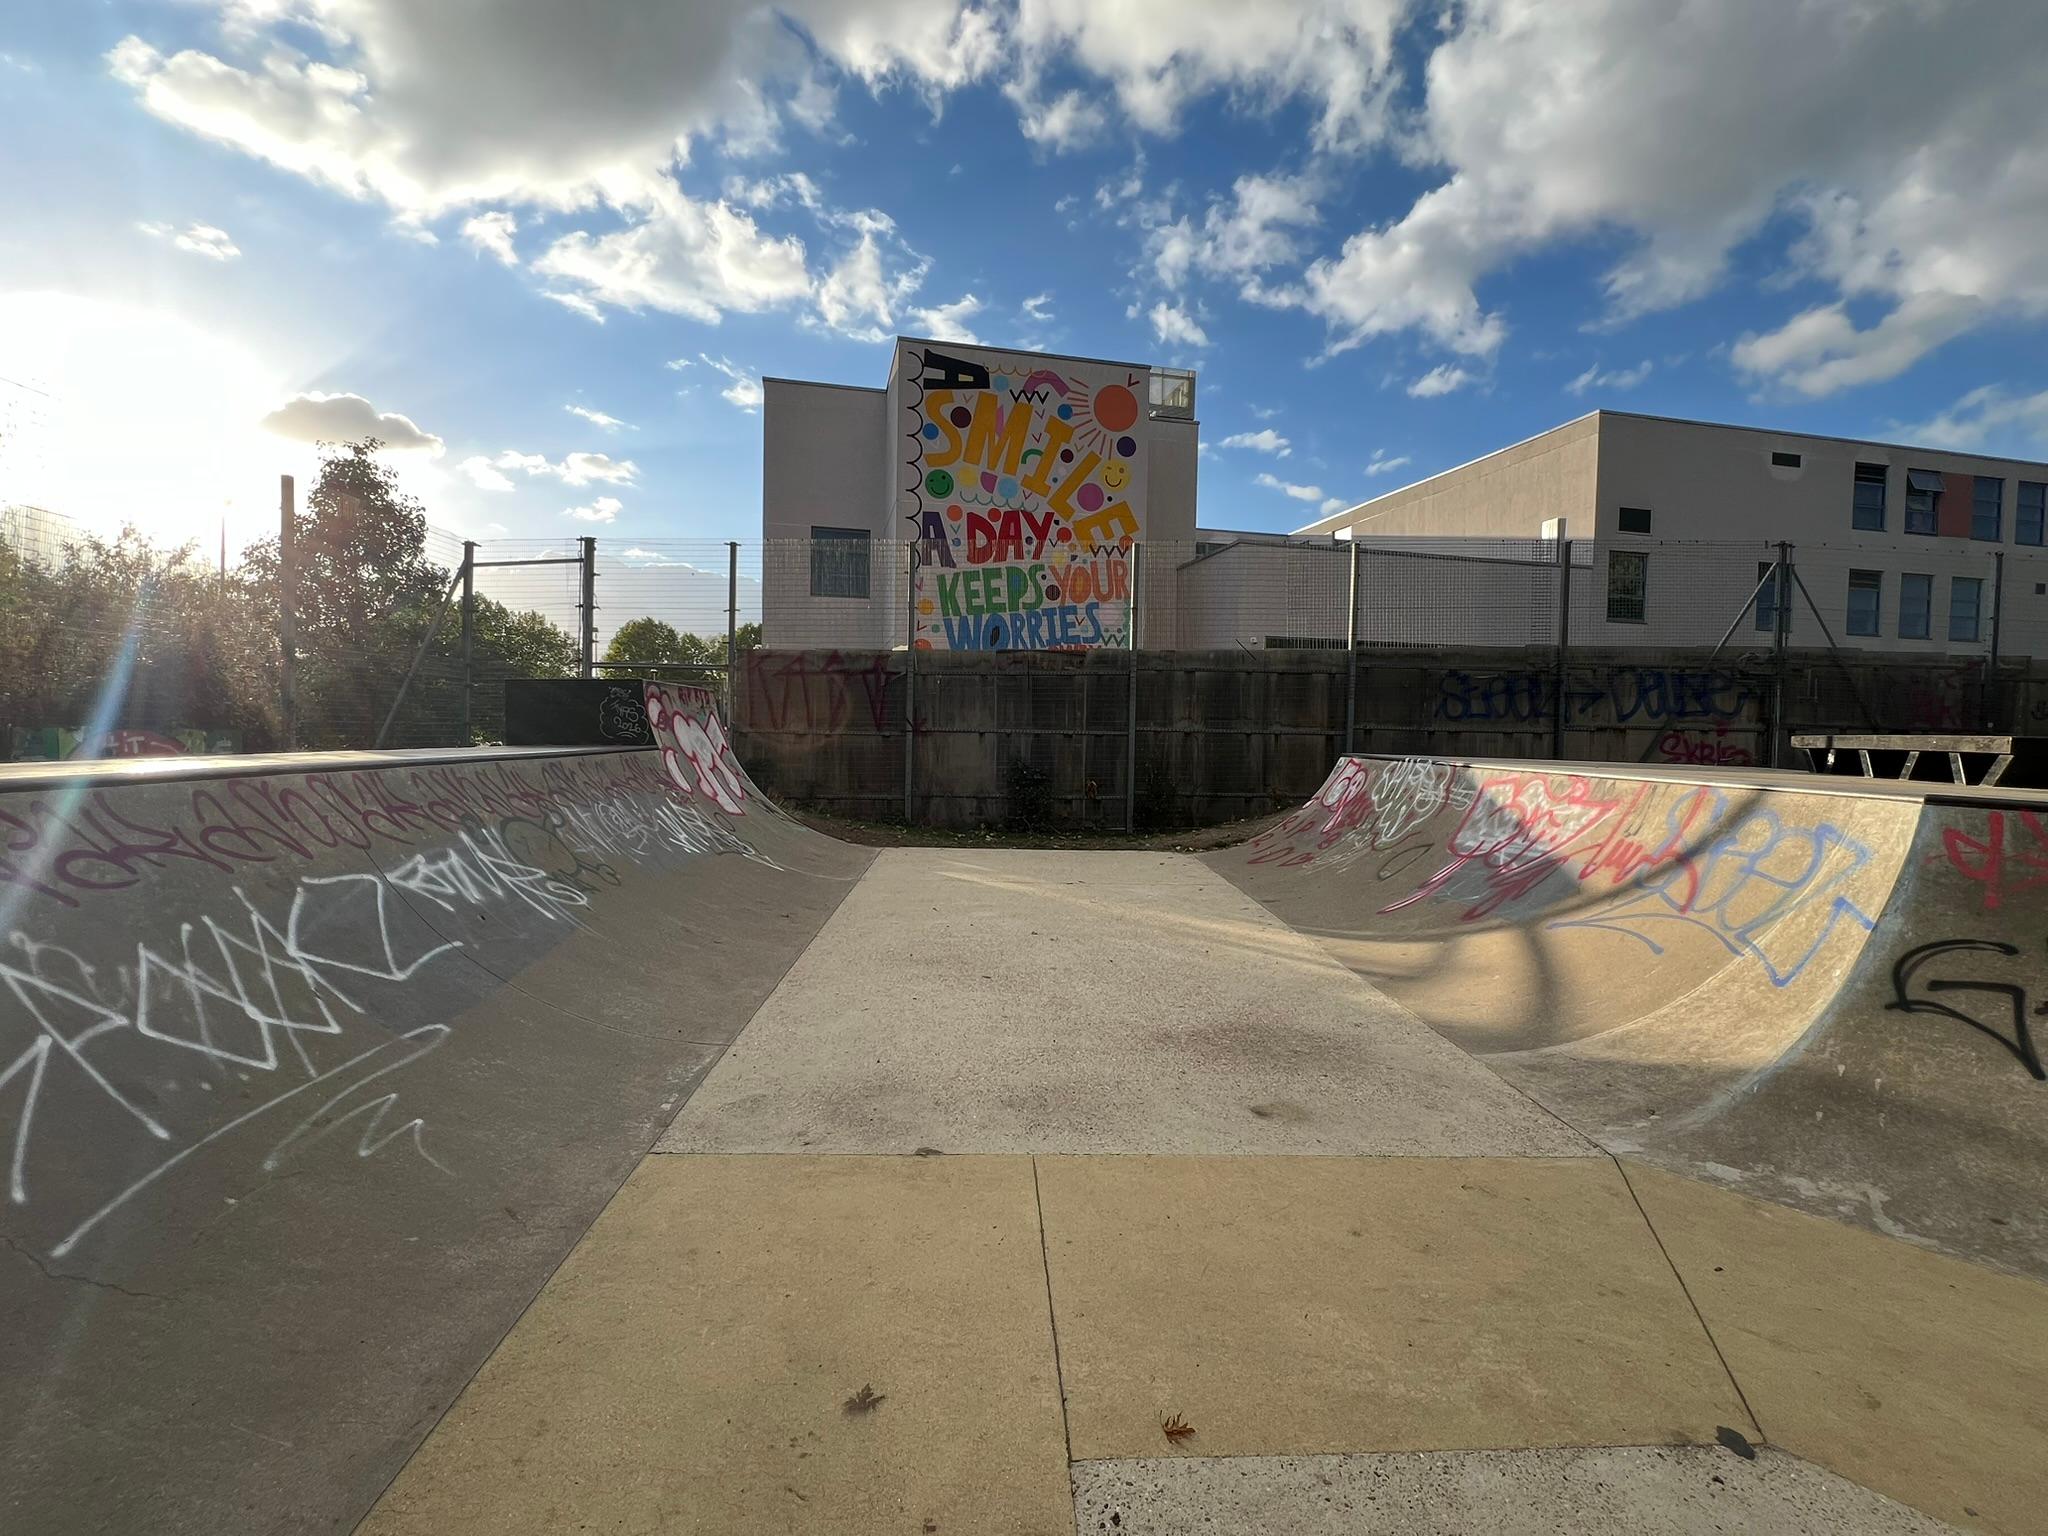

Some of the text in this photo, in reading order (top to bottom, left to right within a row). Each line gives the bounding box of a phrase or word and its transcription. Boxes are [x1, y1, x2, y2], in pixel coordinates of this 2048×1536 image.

[923, 348, 990, 390] A
[923, 389, 1140, 554] SMILE
[921, 511, 1055, 568] A DAY
[936, 559, 1131, 617] KEEPS YOUR
[942, 601, 1102, 651] WORRIES
